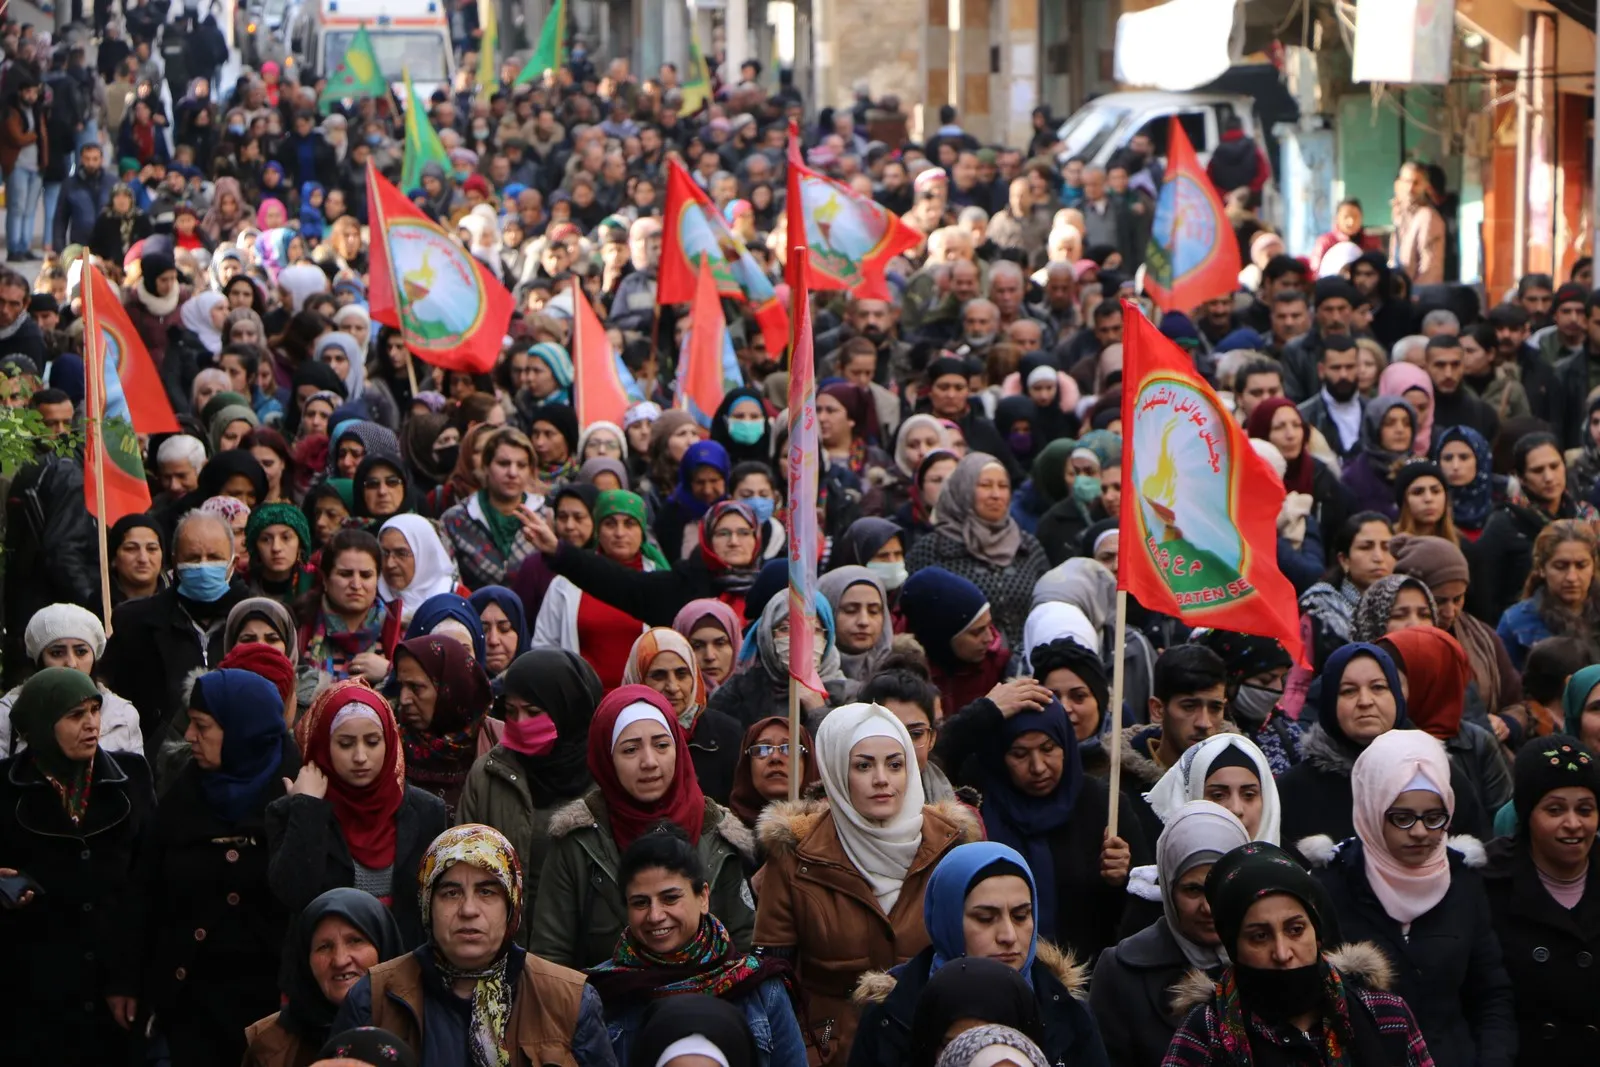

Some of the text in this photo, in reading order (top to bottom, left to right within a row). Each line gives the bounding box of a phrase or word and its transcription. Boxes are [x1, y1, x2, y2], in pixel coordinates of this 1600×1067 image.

[1138, 387, 1221, 474] مجلس عوائل الشهدا
[1175, 578, 1250, 605] BATÊN ŞE
